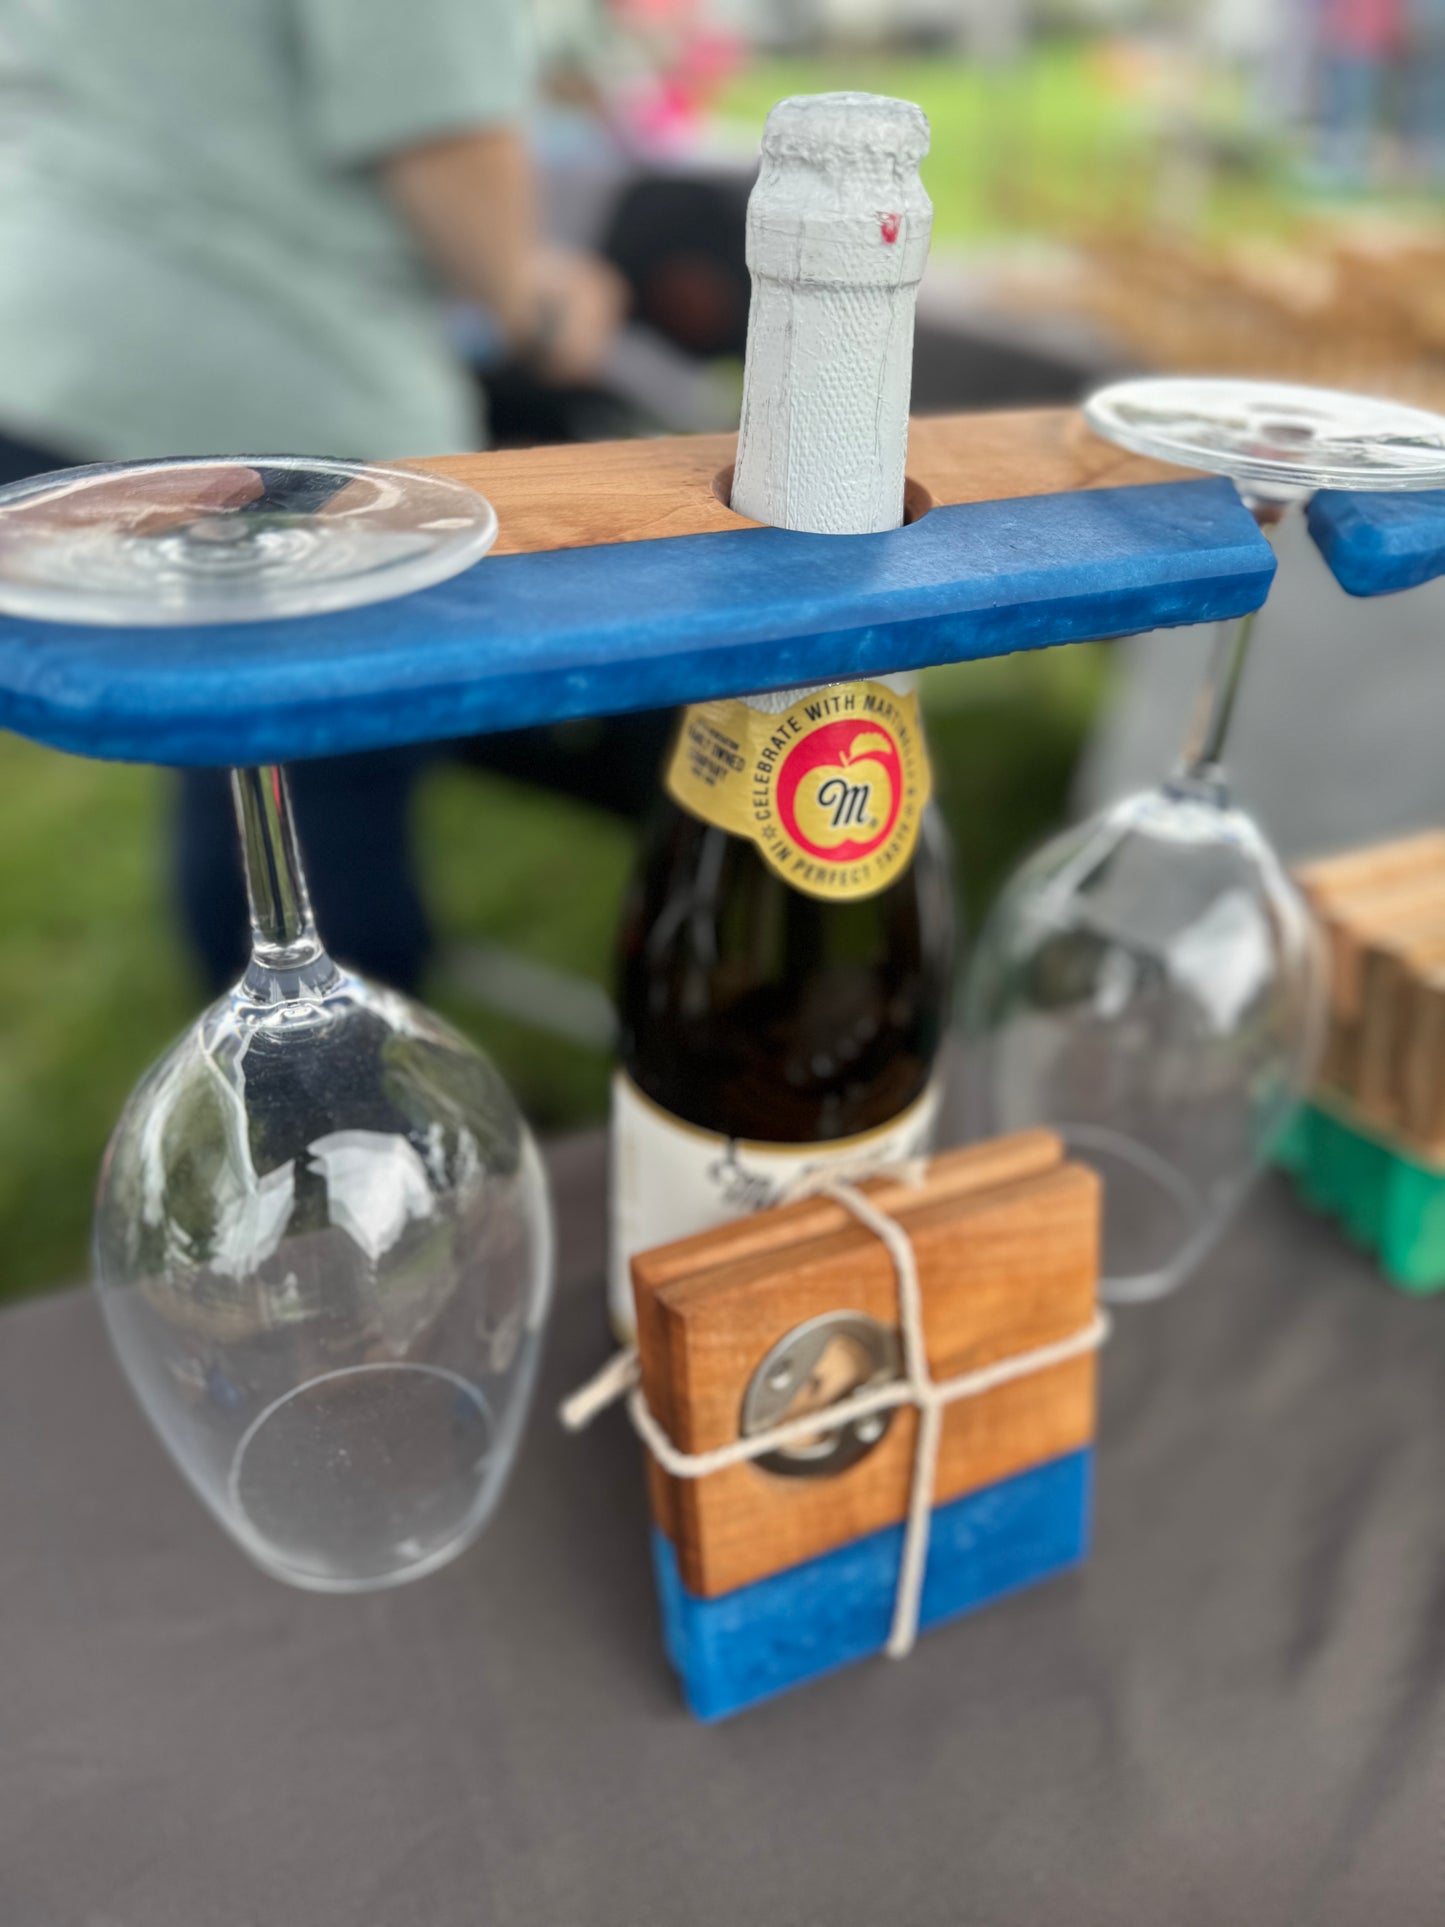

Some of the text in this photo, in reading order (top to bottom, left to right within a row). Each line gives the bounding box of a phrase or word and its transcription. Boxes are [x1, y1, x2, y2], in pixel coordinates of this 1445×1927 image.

[753, 716, 803, 822] CELEBRATE
[804, 694, 857, 722] WITH
[818, 778, 869, 826] M
[769, 838, 793, 864] IN
[792, 856, 872, 889] PERFECT
